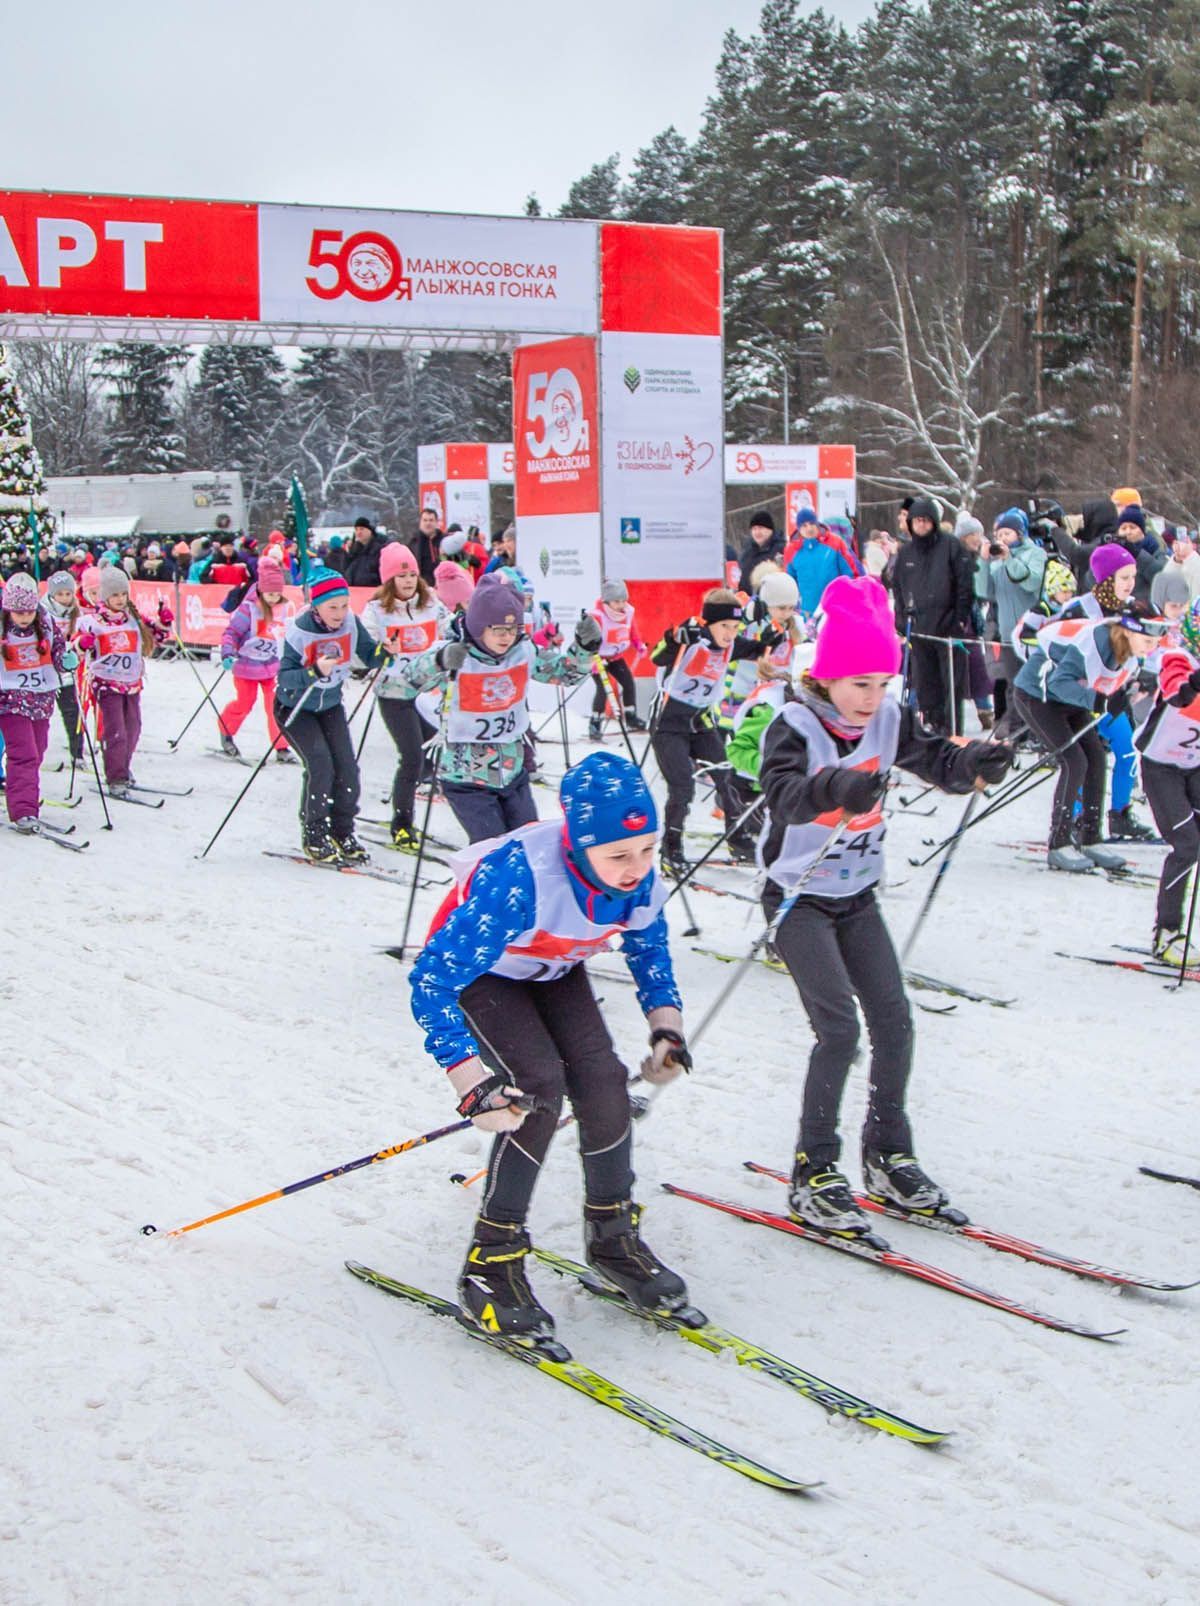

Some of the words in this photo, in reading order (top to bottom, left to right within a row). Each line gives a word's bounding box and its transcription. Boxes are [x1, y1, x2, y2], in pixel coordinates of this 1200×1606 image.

[406, 257, 558, 280] МАНЖОСОВСКАЯ
[415, 279, 495, 297] ЛЫЖНАЯ
[500, 282, 557, 299] ГОНКА
[616, 439, 673, 461] ЗИМА
[475, 711, 516, 741] 238
